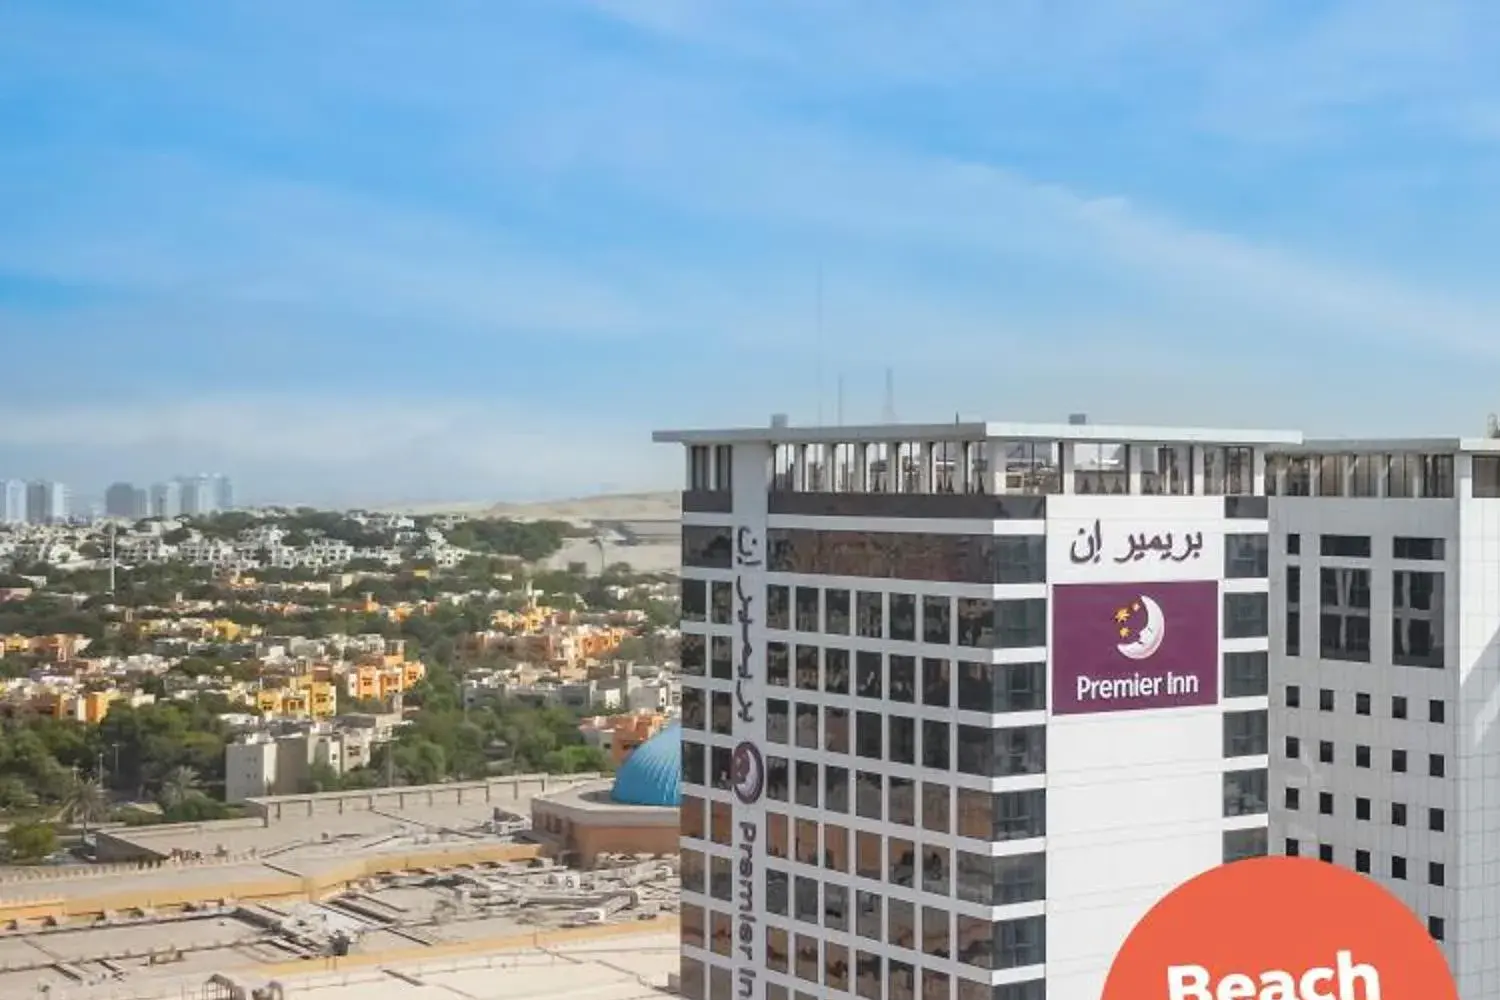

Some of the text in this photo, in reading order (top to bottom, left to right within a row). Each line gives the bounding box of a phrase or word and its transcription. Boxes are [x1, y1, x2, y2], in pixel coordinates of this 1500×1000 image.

[1070, 518, 1203, 563] بريمير إن
[1076, 671, 1199, 701] Premier Inn
[739, 821, 757, 961] Premier
